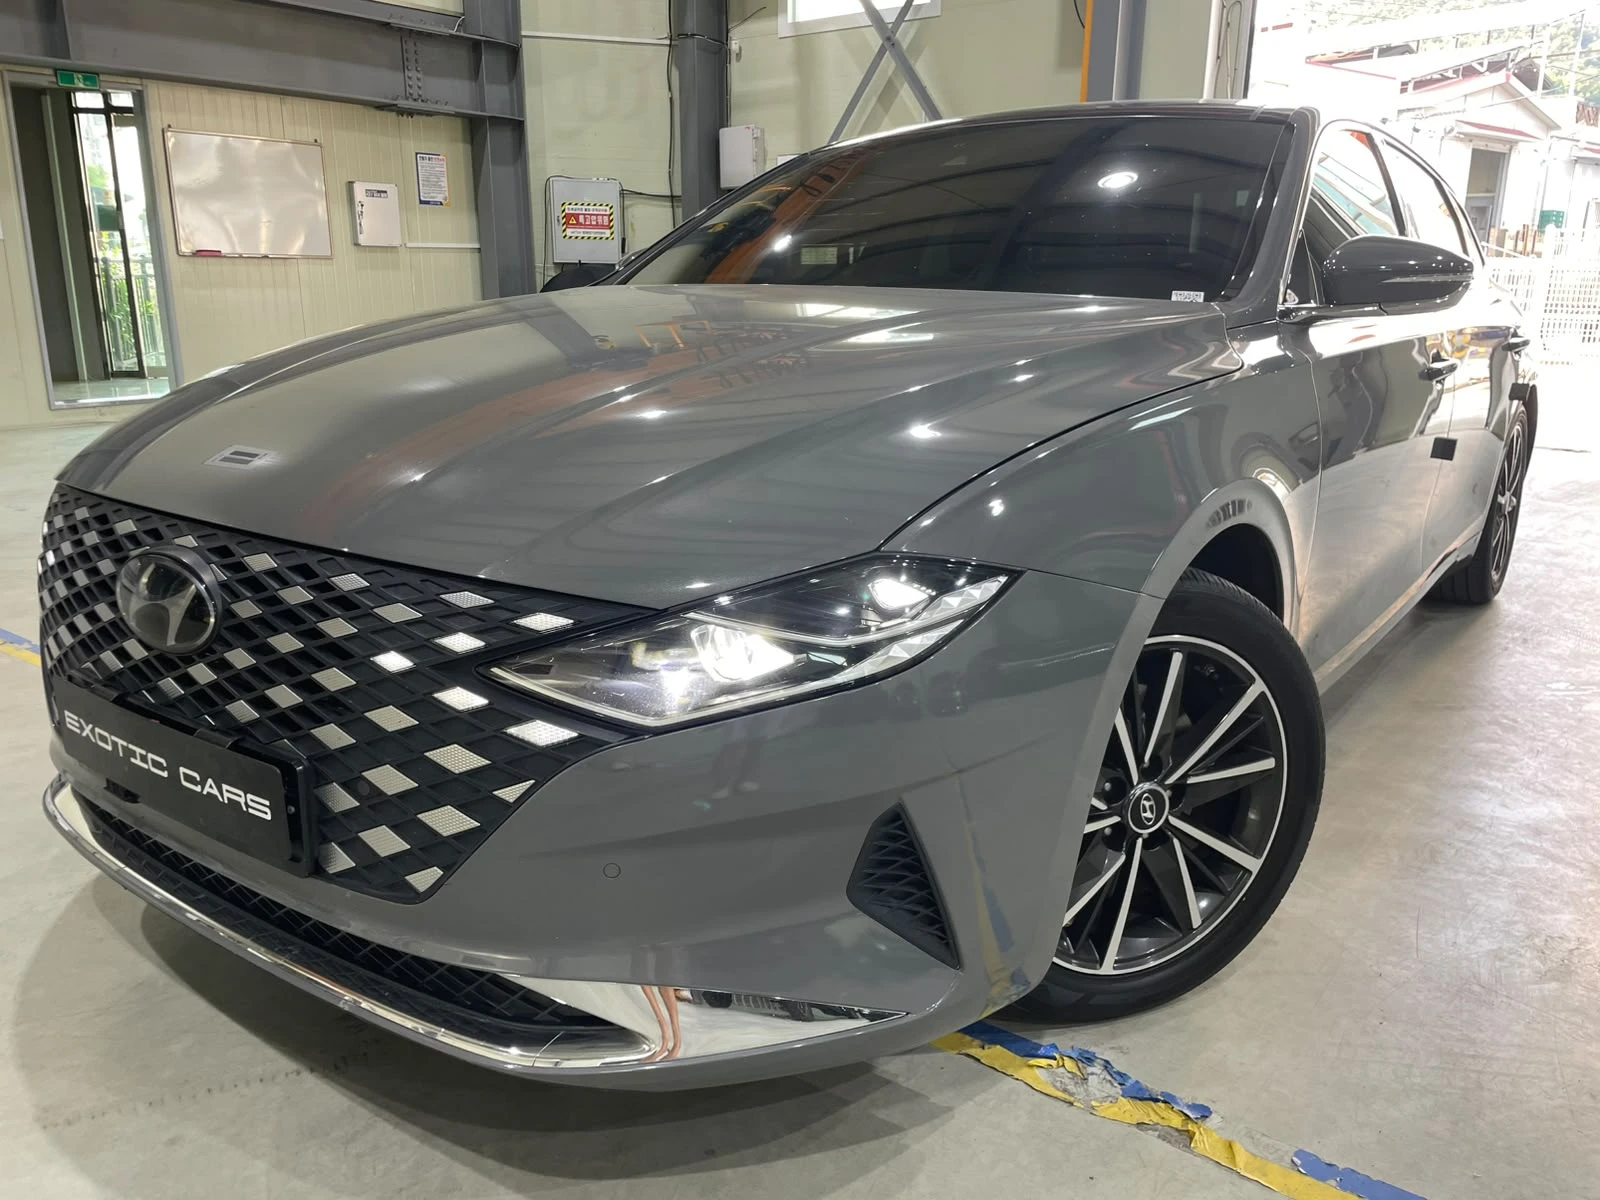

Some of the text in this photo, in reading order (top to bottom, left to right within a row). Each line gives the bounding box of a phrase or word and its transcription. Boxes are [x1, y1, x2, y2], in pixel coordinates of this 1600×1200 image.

[579, 214, 609, 225] 특고압위험
[64, 710, 272, 821] EXOTIC CARS
